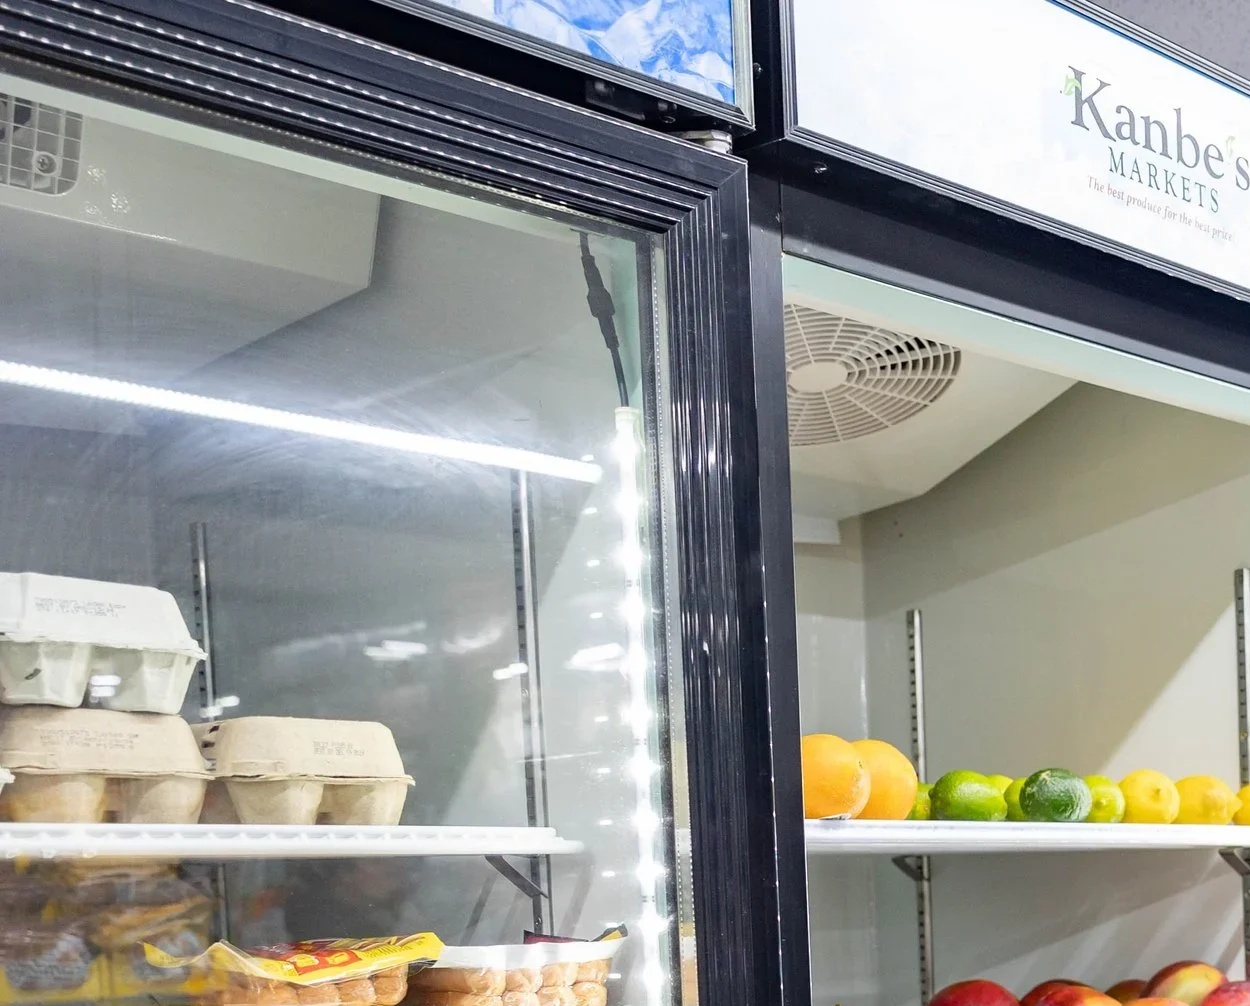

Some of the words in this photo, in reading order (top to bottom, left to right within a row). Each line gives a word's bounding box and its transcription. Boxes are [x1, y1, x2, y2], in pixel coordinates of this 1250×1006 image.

[1067, 65, 1250, 191] Kanbe's
[1087, 174, 1105, 193] The
[1107, 183, 1125, 201] best
[1126, 193, 1163, 215] produce
[1162, 205, 1179, 220] for
[1179, 212, 1192, 227] the
[1194, 217, 1211, 234] best
[1107, 146, 1220, 213] MARKETS
